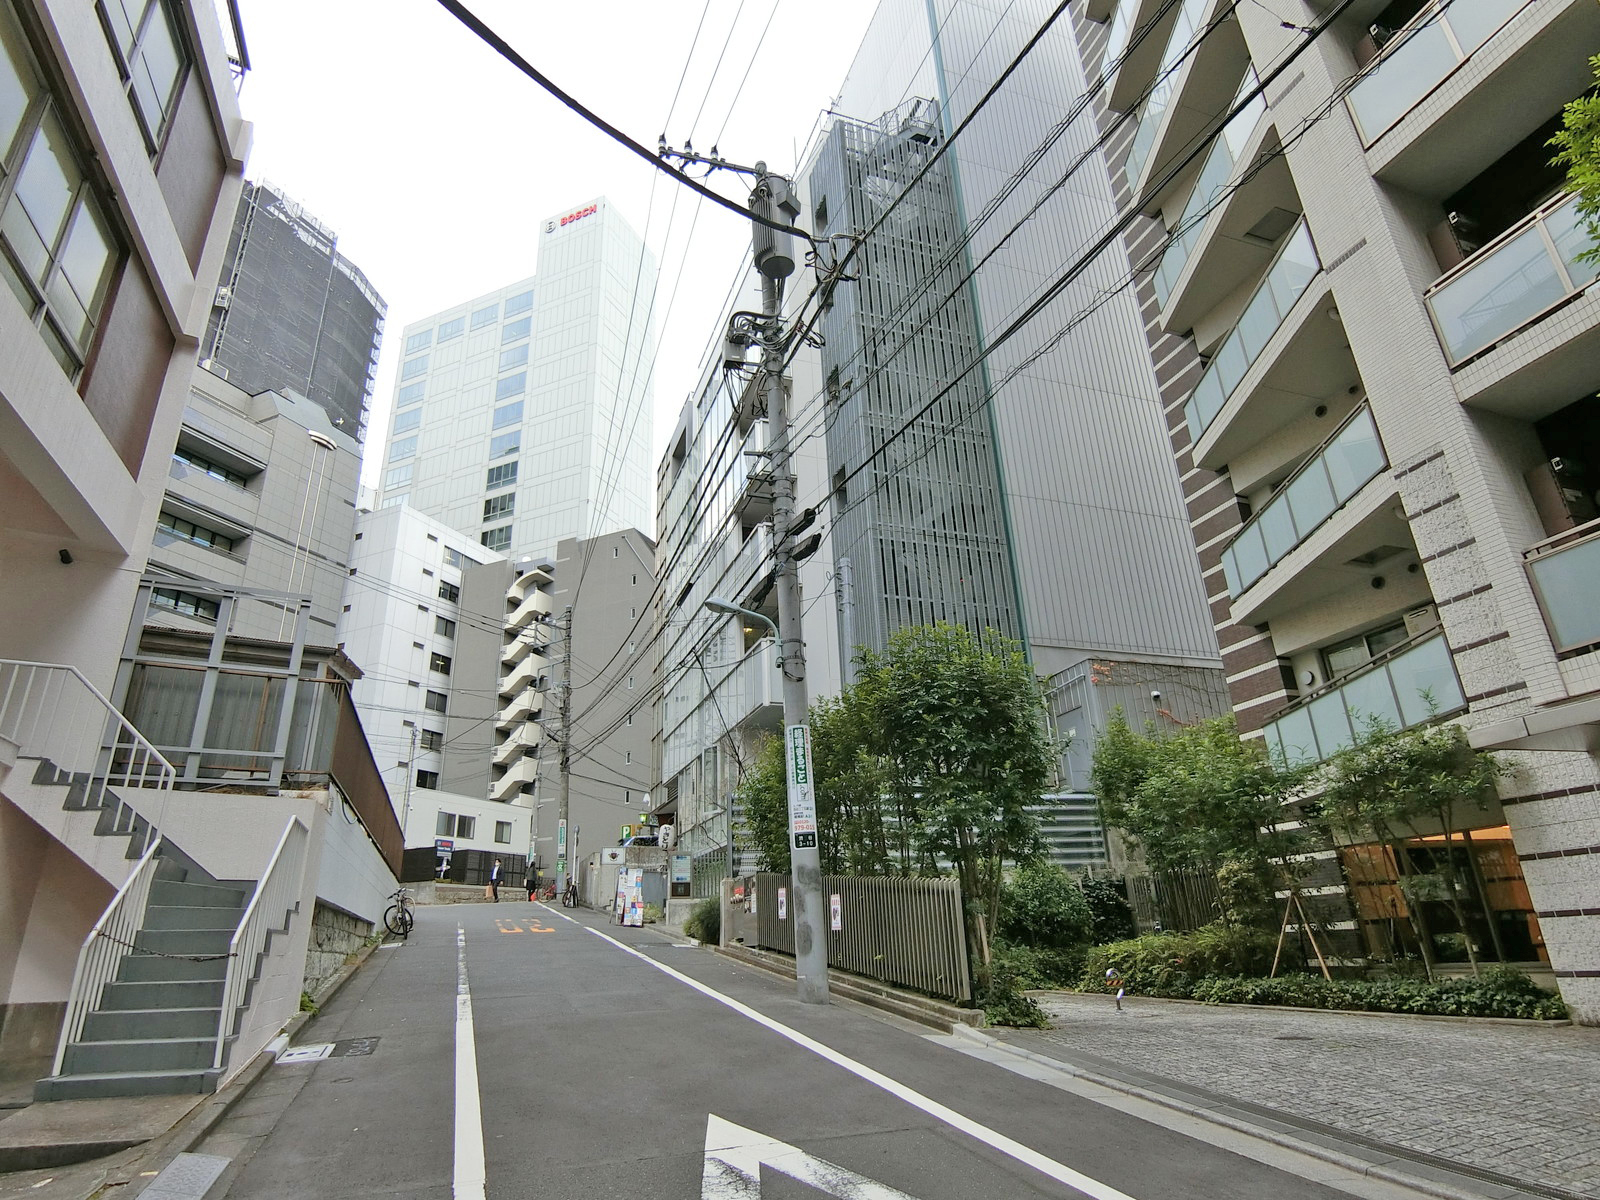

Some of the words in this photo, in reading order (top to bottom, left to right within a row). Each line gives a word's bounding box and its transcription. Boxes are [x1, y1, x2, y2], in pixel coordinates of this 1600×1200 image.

[560, 204, 597, 226] BOSCH
[623, 826, 631, 838] P
[661, 825, 671, 851] やきとり
